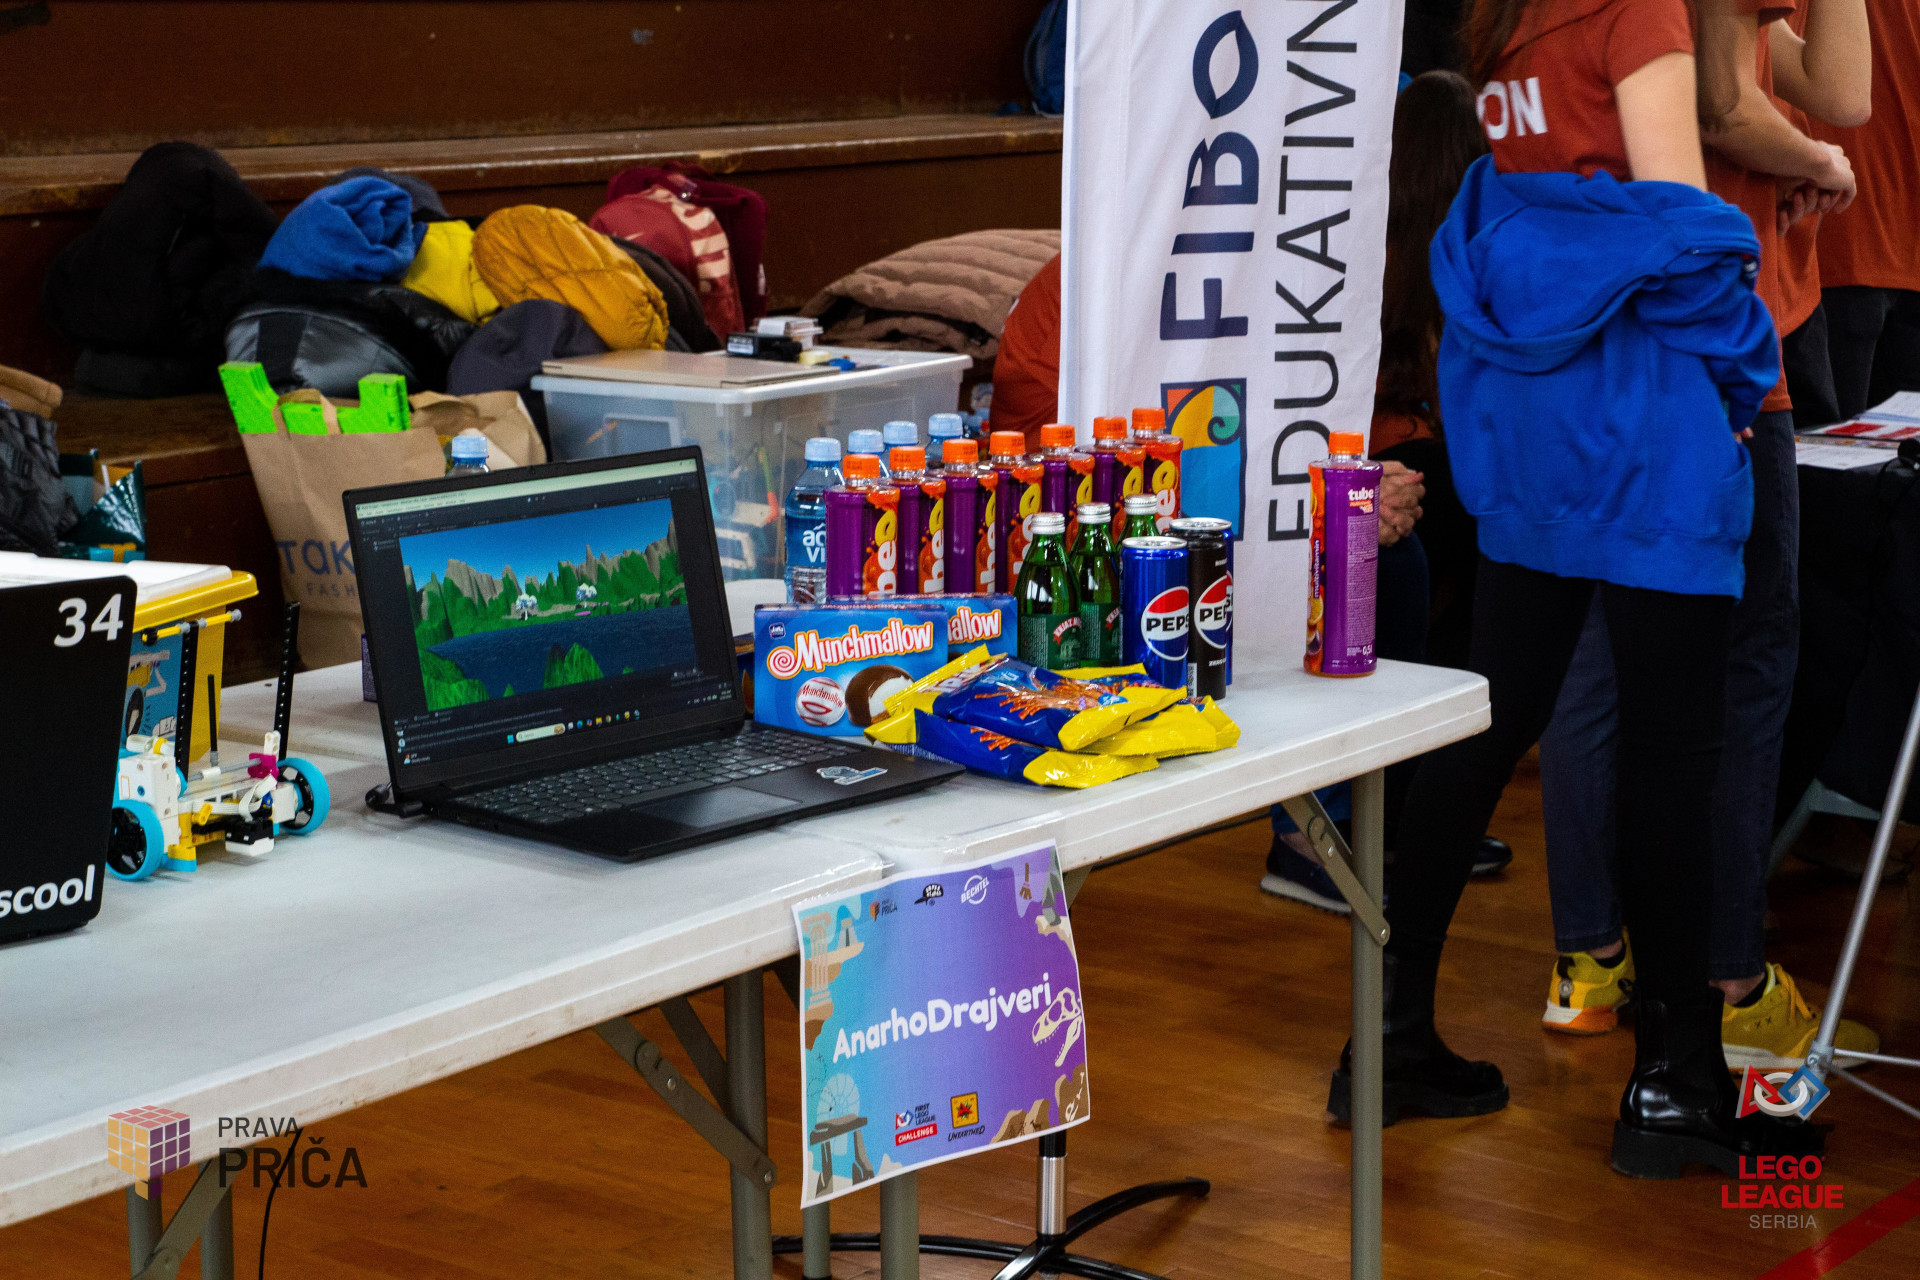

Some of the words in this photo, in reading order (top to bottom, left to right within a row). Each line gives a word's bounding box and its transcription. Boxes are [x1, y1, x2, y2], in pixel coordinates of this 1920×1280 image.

[1476, 77, 1548, 140] ON
[1160, 10, 1259, 340] FIBO
[1348, 487, 1374, 501] tube
[54, 593, 124, 647] 34
[949, 608, 1001, 643] allow
[768, 618, 934, 680] Munchmallow
[0, 864, 96, 918] scool
[961, 877, 990, 904] BECHTEL
[832, 972, 1052, 1064] AnarhoDrajveri
[915, 1103, 930, 1112] FIRST
[898, 1126, 934, 1144] CHALLENGE
